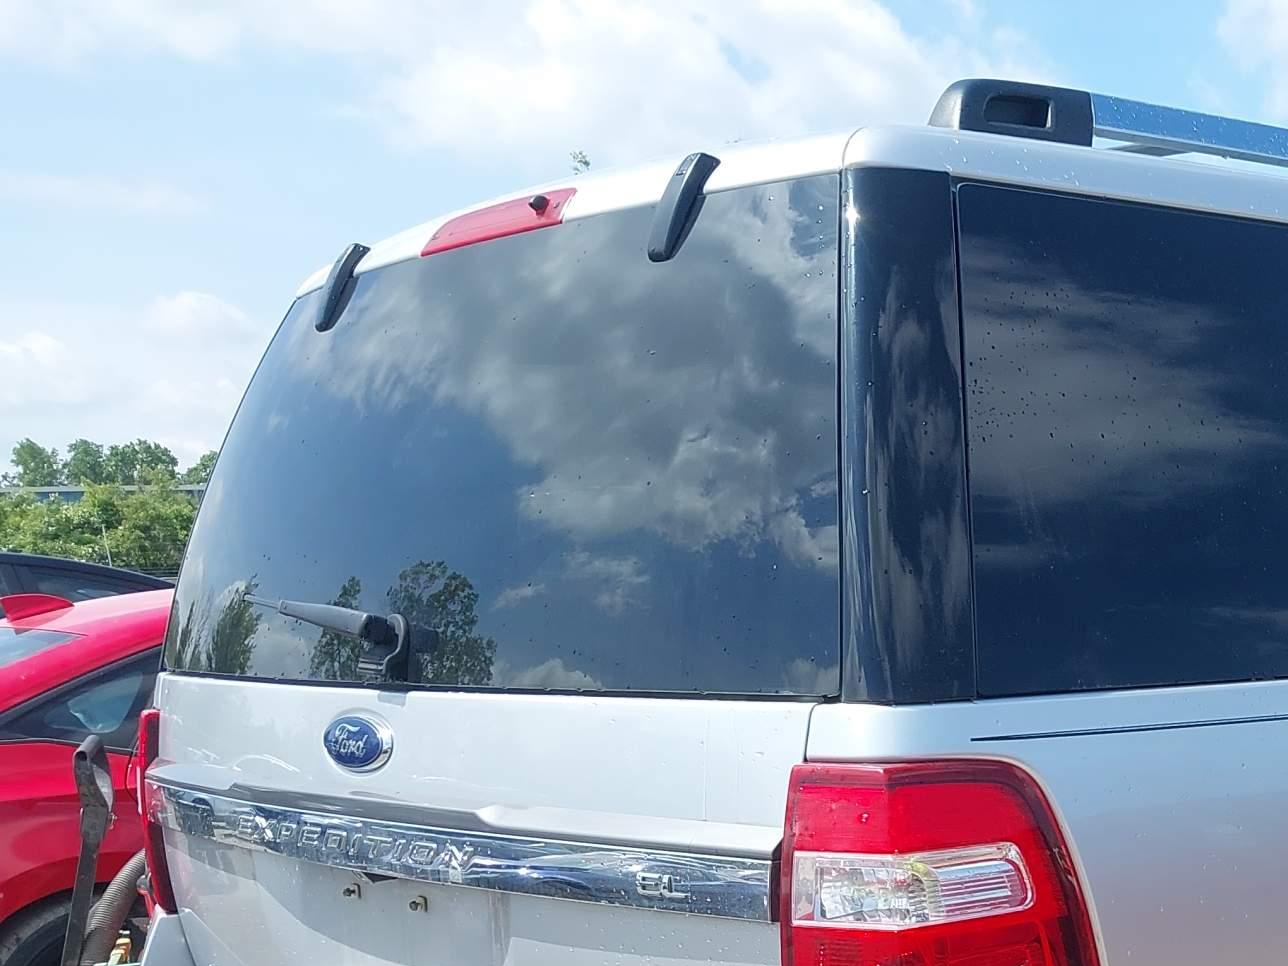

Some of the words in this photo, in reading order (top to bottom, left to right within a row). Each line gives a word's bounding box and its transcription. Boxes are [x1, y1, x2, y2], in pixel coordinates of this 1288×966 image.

[327, 723, 369, 758] Ford
[234, 813, 475, 869] EXPEDITION
[636, 872, 690, 898] EL
